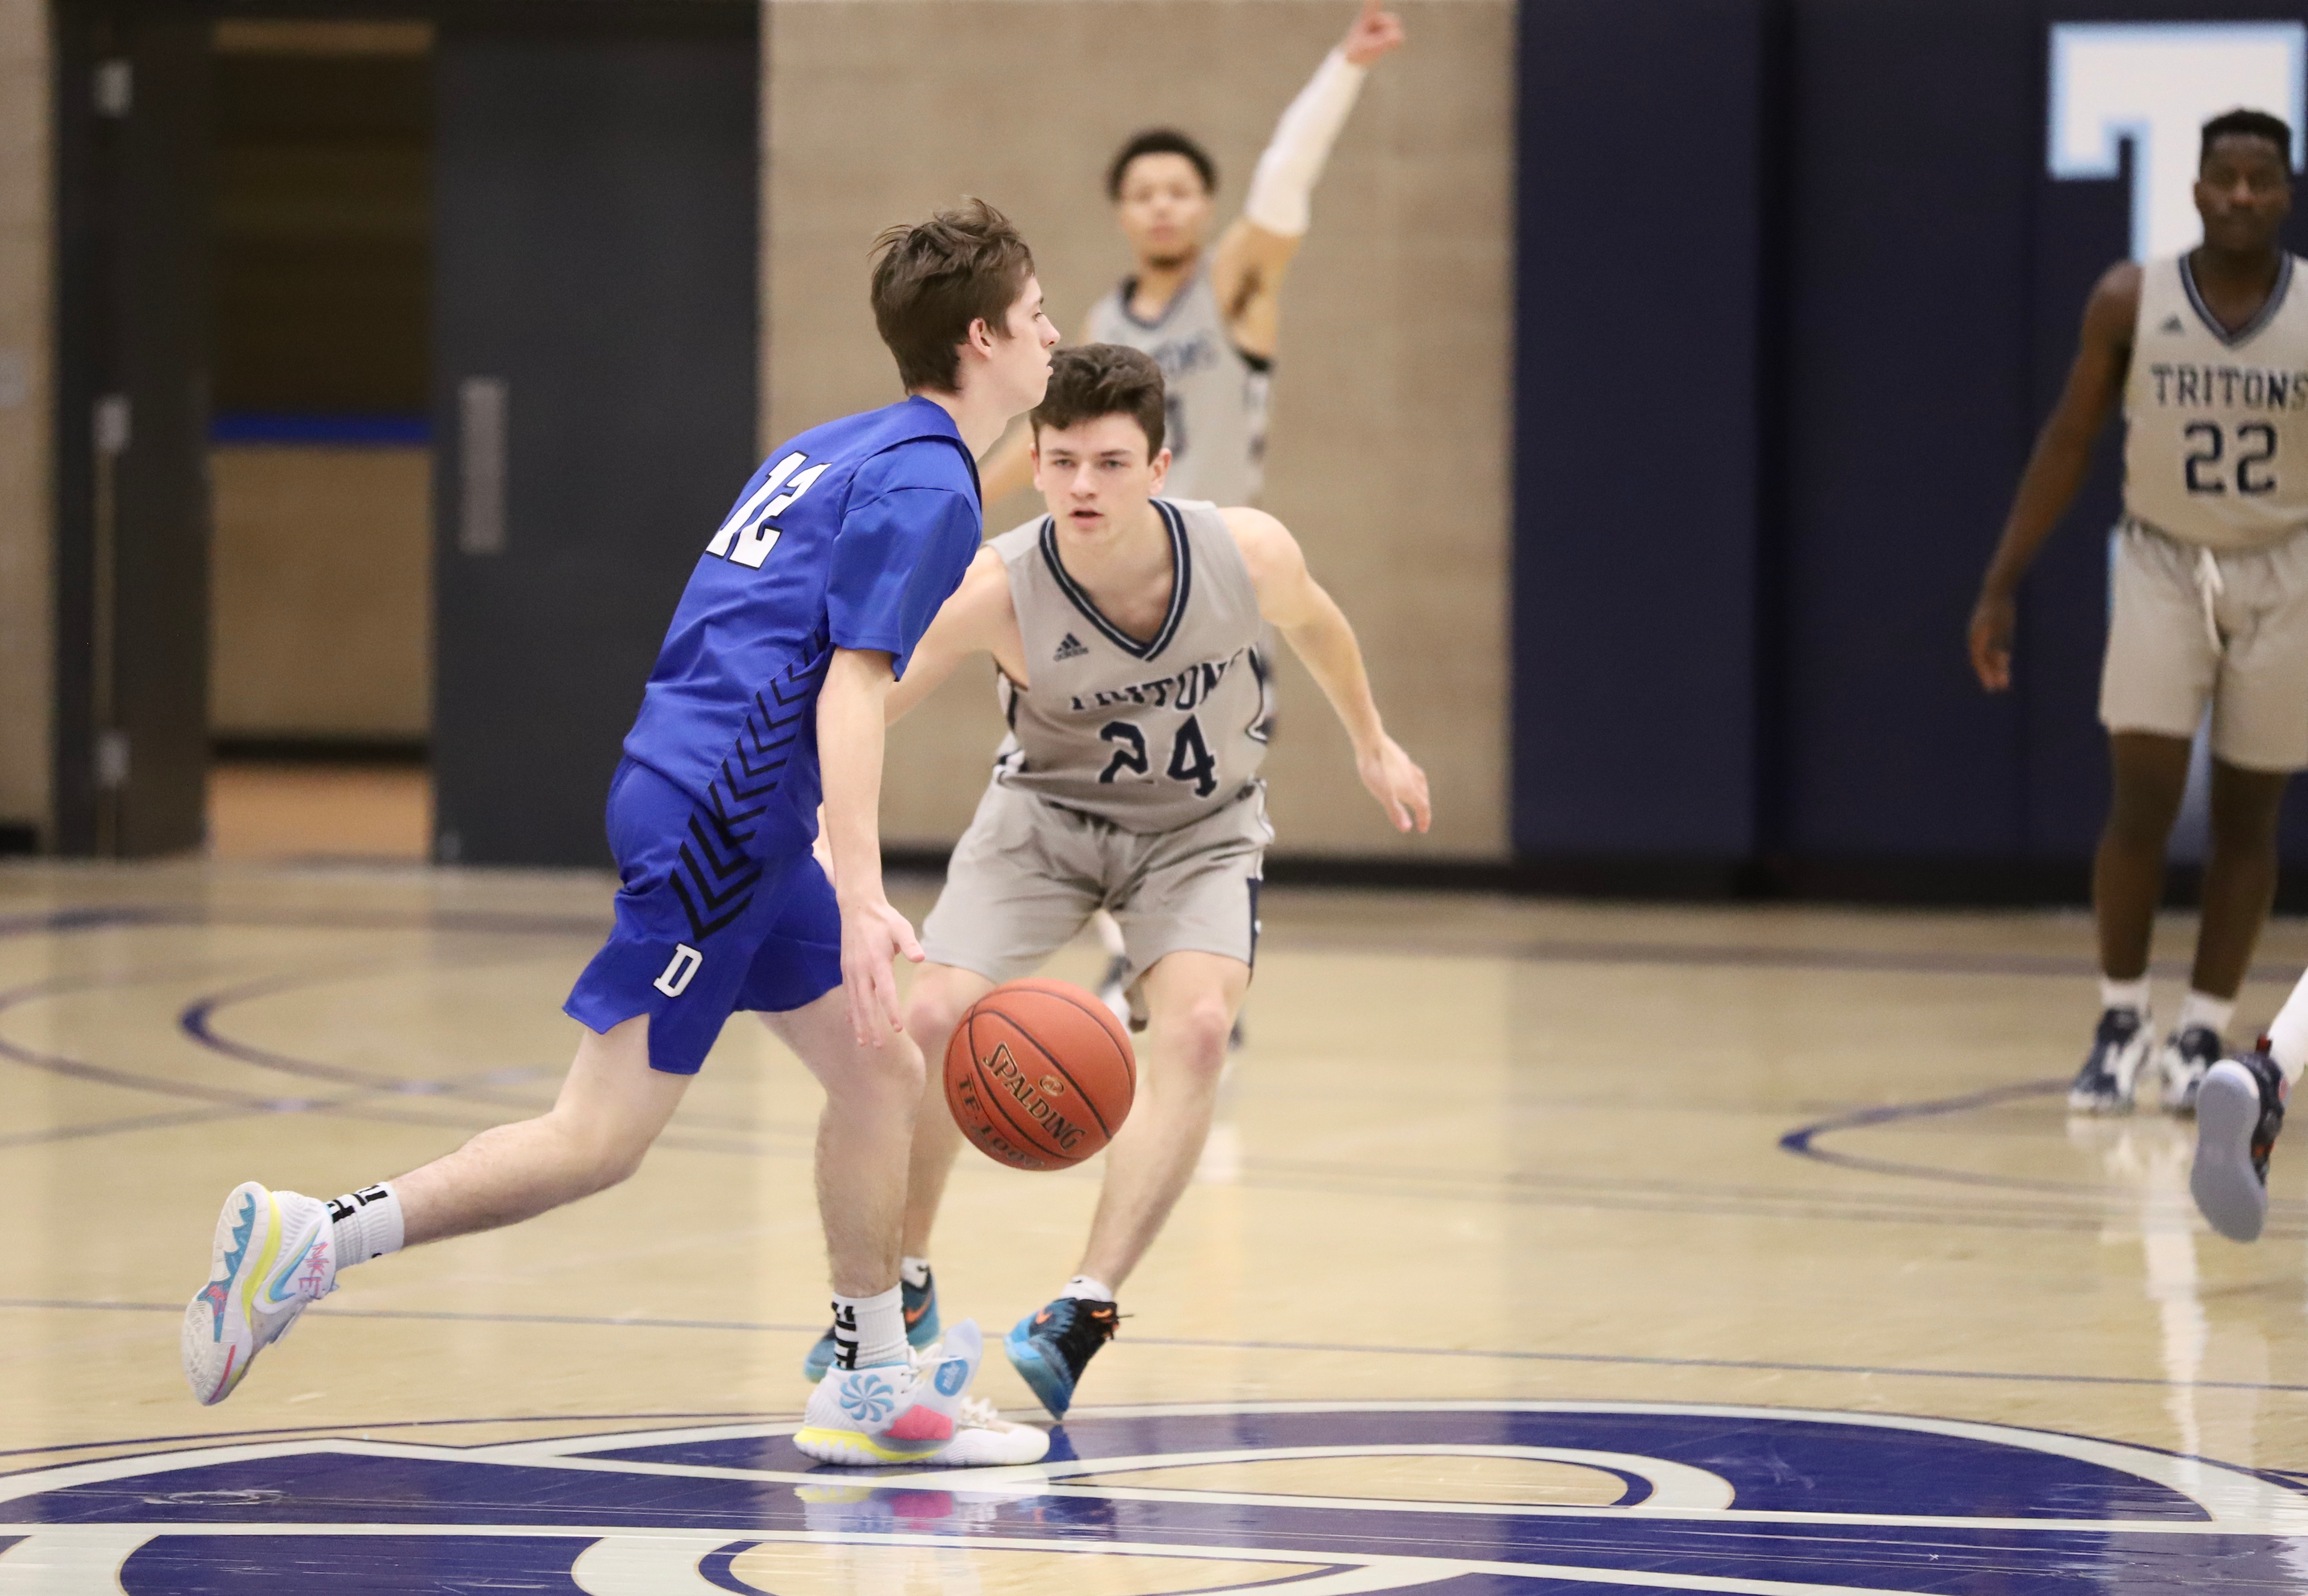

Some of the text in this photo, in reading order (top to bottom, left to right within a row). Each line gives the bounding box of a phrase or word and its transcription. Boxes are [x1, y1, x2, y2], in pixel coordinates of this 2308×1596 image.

[2184, 421, 2277, 494] 22
[706, 451, 831, 570] 12
[1099, 714, 1218, 798] 24
[652, 942, 703, 998] D
[982, 1041, 1087, 1152] SPALDING
[298, 1241, 329, 1299] NIKE
